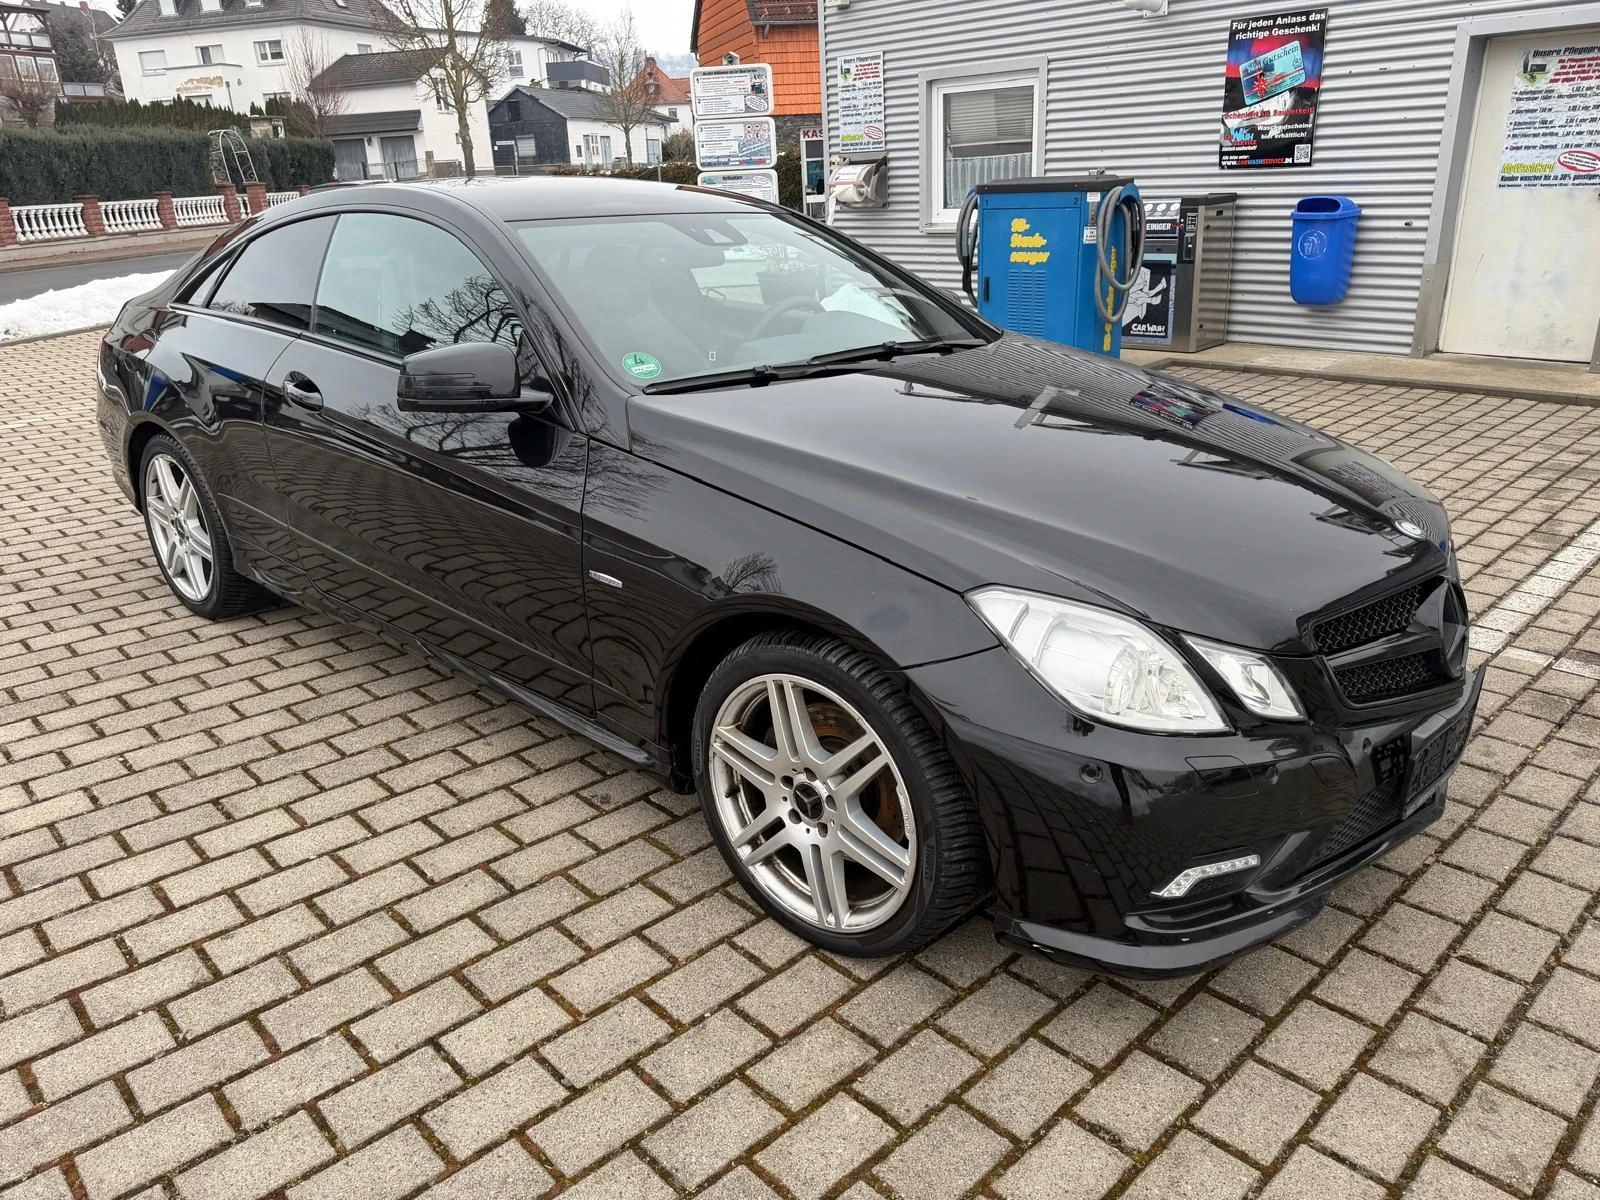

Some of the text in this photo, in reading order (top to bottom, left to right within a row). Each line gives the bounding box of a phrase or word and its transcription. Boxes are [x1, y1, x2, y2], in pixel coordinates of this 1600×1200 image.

[1232, 12, 1326, 30] Für jeden Anlass das
[1235, 23, 1320, 40] richtige Geschenk!
[1263, 45, 1299, 65] Gutschein
[1533, 49, 1561, 57] Unsere
[1257, 123, 1312, 132] Waschgutscheine
[1275, 131, 1307, 139] erhältlich!
[1073, 197, 1079, 206] 2
[1145, 222, 1171, 230] EINIGER
[1132, 323, 1165, 332] CAR WASH
[634, 354, 644, 364] 4
